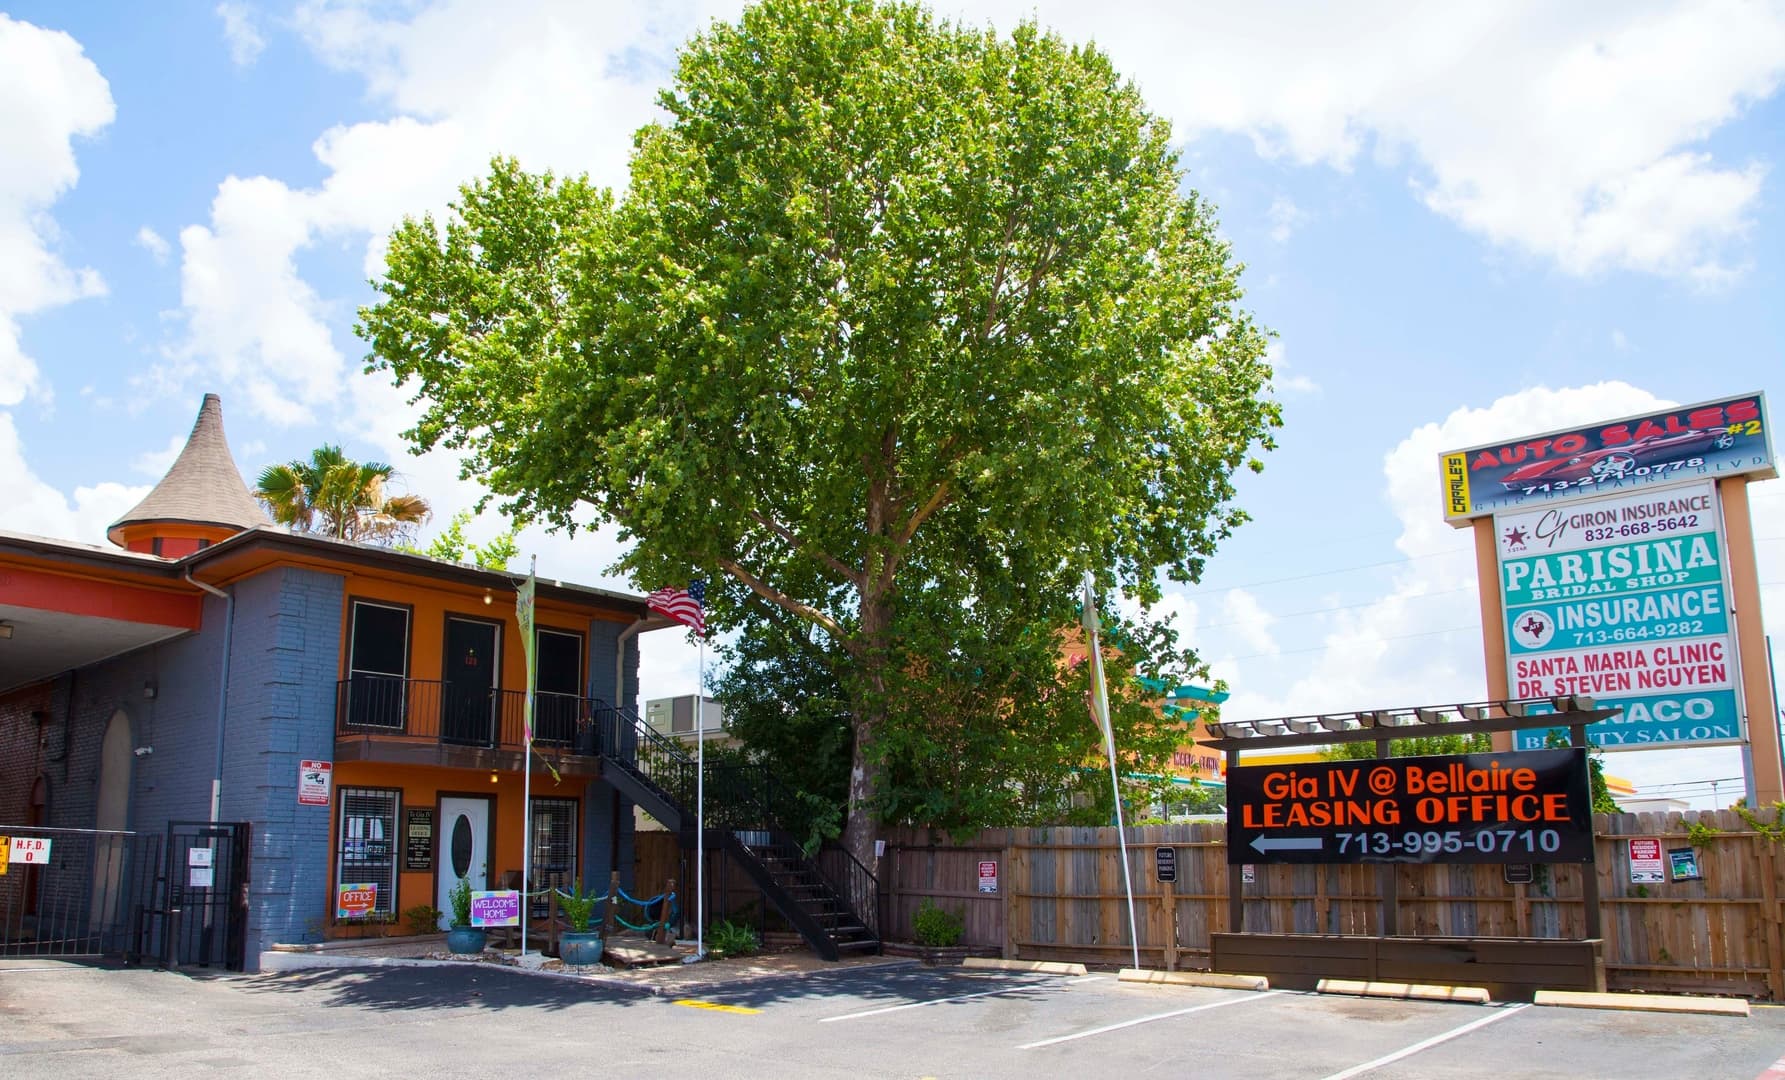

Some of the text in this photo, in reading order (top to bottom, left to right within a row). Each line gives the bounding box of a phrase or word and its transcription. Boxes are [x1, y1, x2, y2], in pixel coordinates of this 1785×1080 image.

[1471, 400, 1759, 471] AUTO SALES
[1727, 420, 1762, 436] #2
[1449, 458, 1467, 512] CAPRILE'S
[1522, 457, 1704, 495] 713-271-0778
[1570, 509, 1617, 530] GIRON
[1621, 495, 1711, 521] INSURANCE
[1584, 515, 1699, 543] 832-668-5642
[1504, 536, 1718, 592] PARISINA
[1531, 571, 1691, 601] BRIDAL SHOP
[1556, 588, 1721, 631] INSURANCE
[1572, 620, 1704, 645] 713-664-9282
[1516, 641, 1724, 678] SANTA MARIA CLINIC
[1517, 663, 1727, 699] DR. STEVEN NGUYEN
[1636, 724, 1731, 743] SALON
[1263, 760, 1537, 800] Gia IV @ Bellaire
[1242, 794, 1572, 829] LEASING OFFICE
[16, 839, 45, 850] H.F.D.
[1335, 829, 1561, 854] 713-995-0710
[343, 891, 373, 902] OFFICE
[473, 899, 517, 909] WELCOME
[484, 909, 508, 918] HOME
